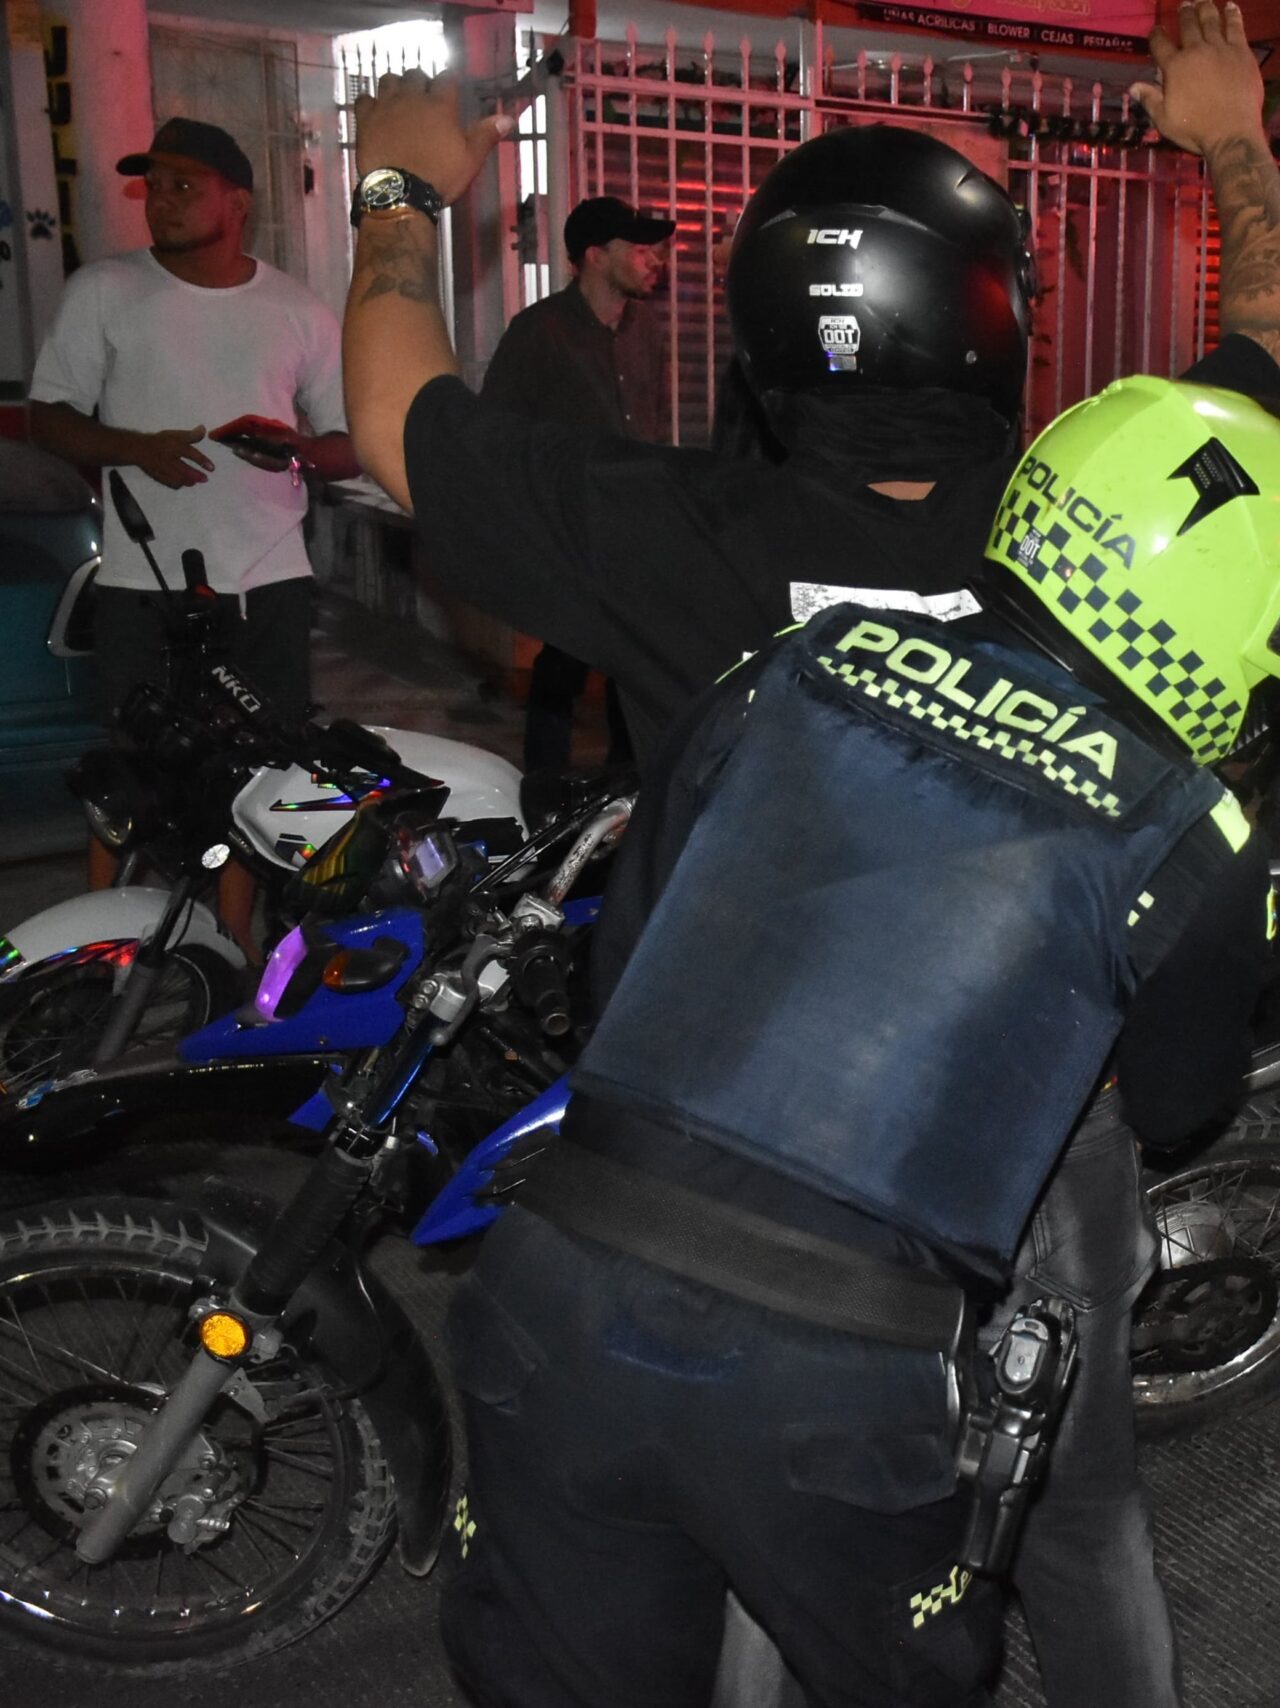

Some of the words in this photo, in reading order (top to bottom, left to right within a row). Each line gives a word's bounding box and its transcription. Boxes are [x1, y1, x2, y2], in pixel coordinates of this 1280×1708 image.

[987, 23, 1030, 39] BLOWER
[1041, 30, 1074, 44] CEJAS
[807, 229, 863, 249] ICH
[824, 329, 855, 344] DOT
[1017, 456, 1136, 571] POLICÍA
[1020, 535, 1041, 559] DOT
[835, 620, 1118, 780] POLICÍA
